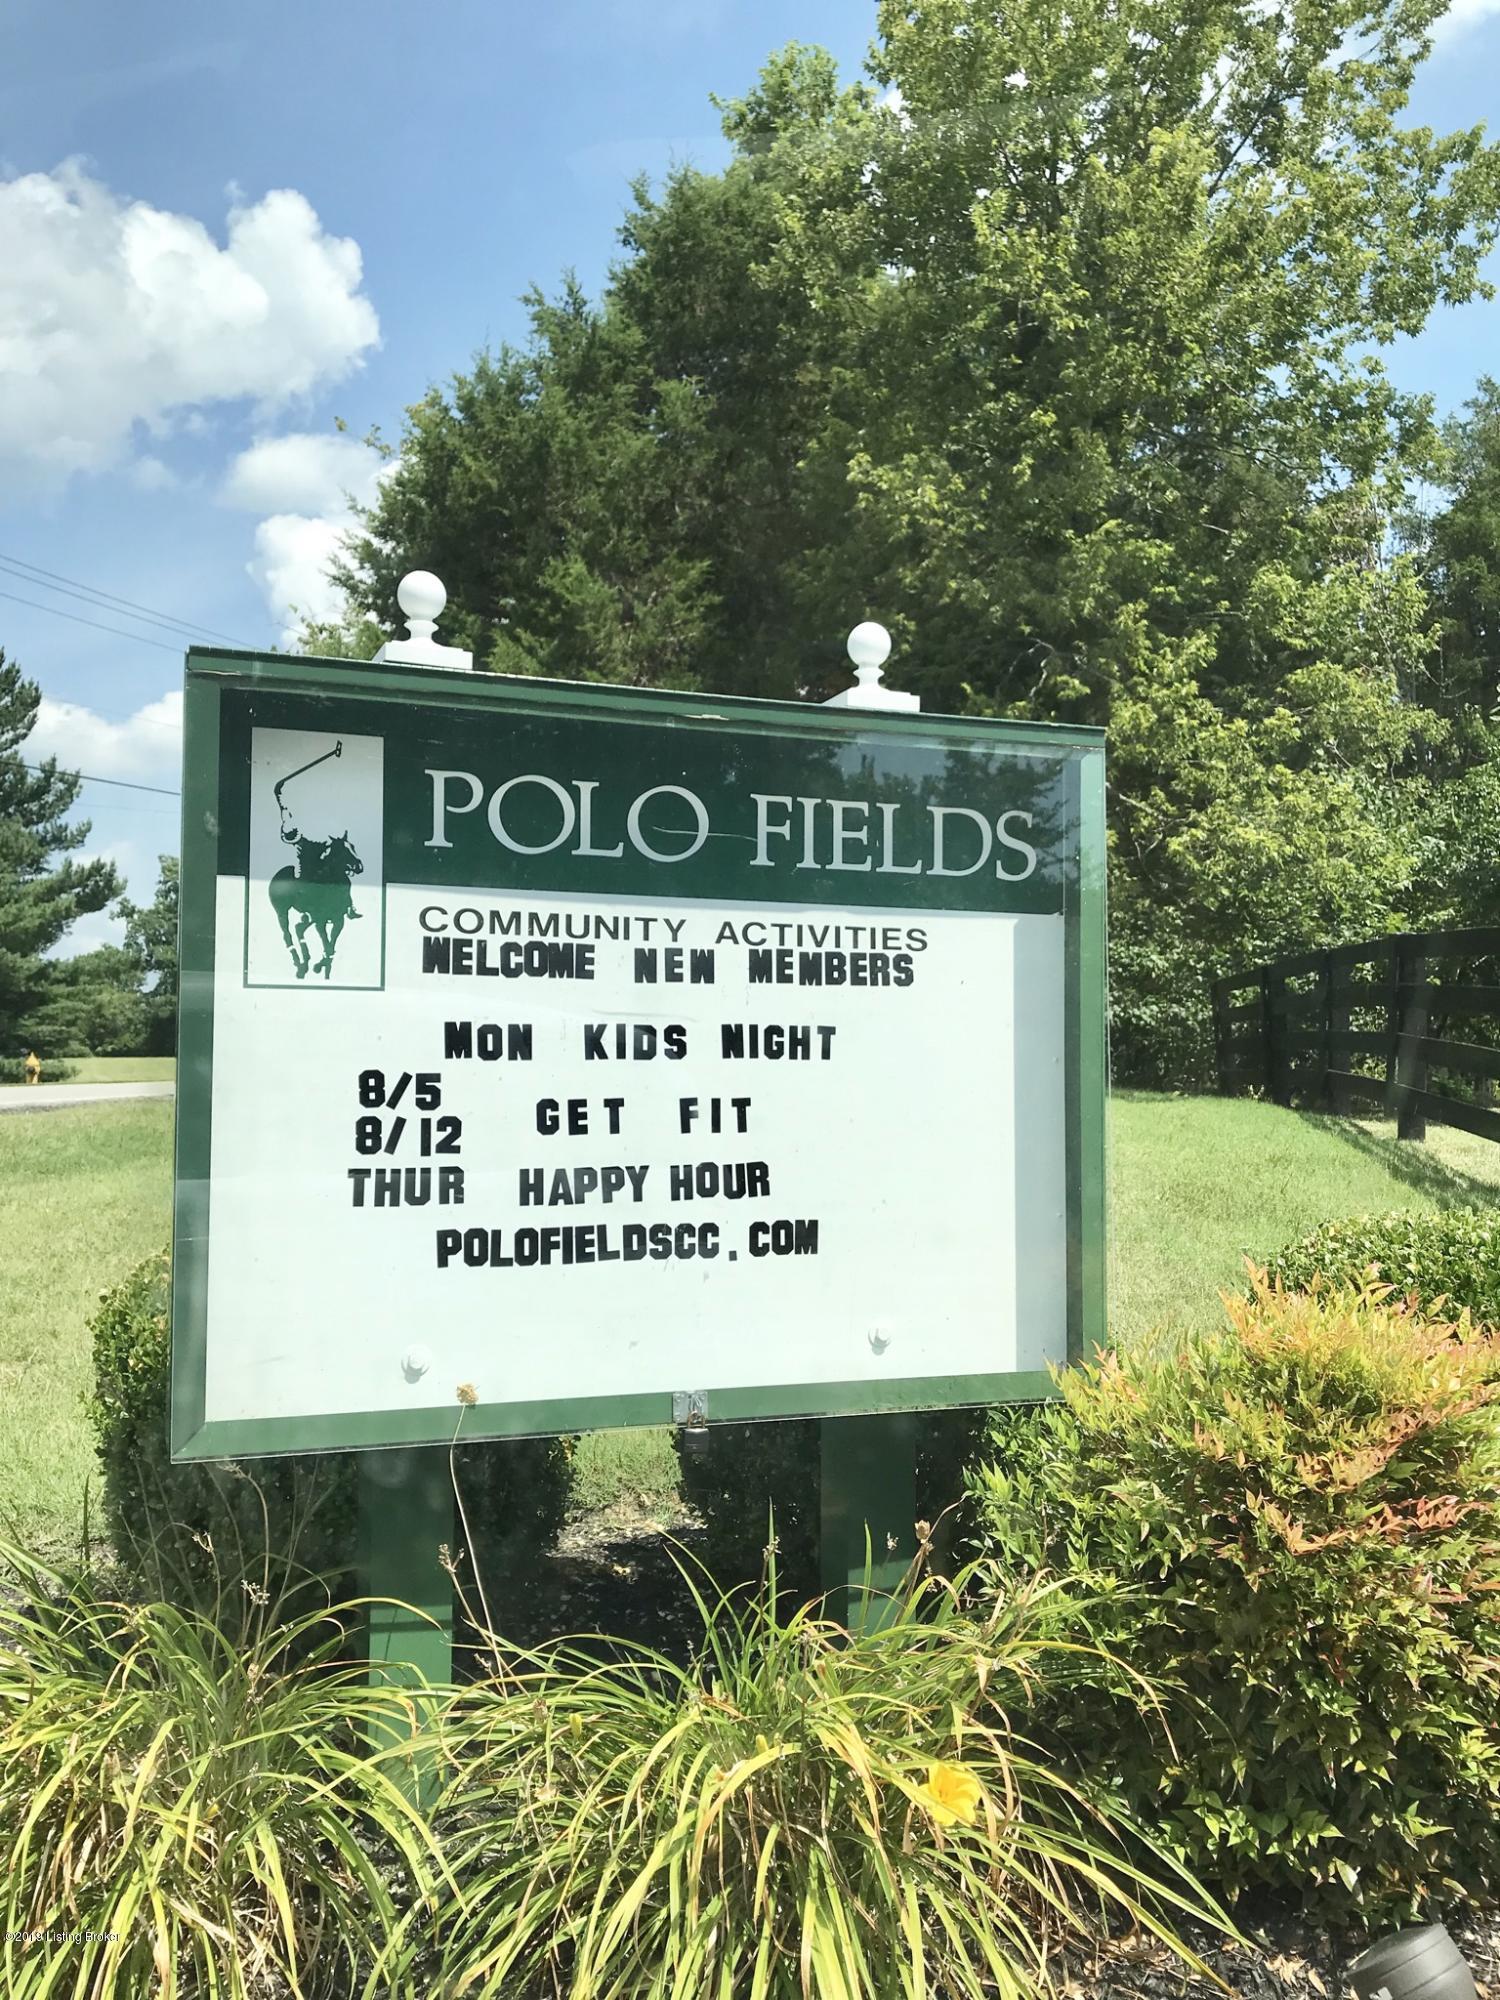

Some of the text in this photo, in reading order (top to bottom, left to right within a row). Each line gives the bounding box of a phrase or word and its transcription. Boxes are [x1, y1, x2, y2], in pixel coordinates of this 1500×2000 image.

[425, 769, 1038, 882] POLO FIELDS
[418, 906, 928, 952] COMMUNITY ACTIVITIES
[423, 936, 914, 987] WELCOME NEW MEMBERS
[445, 1022, 837, 1062] MON KIDS NIGHT
[359, 1070, 442, 1111] 8/5
[356, 1116, 463, 1157] 8/12
[537, 1098, 752, 1136] GET FIT
[348, 1161, 771, 1208] THUR HAPPY HOUR
